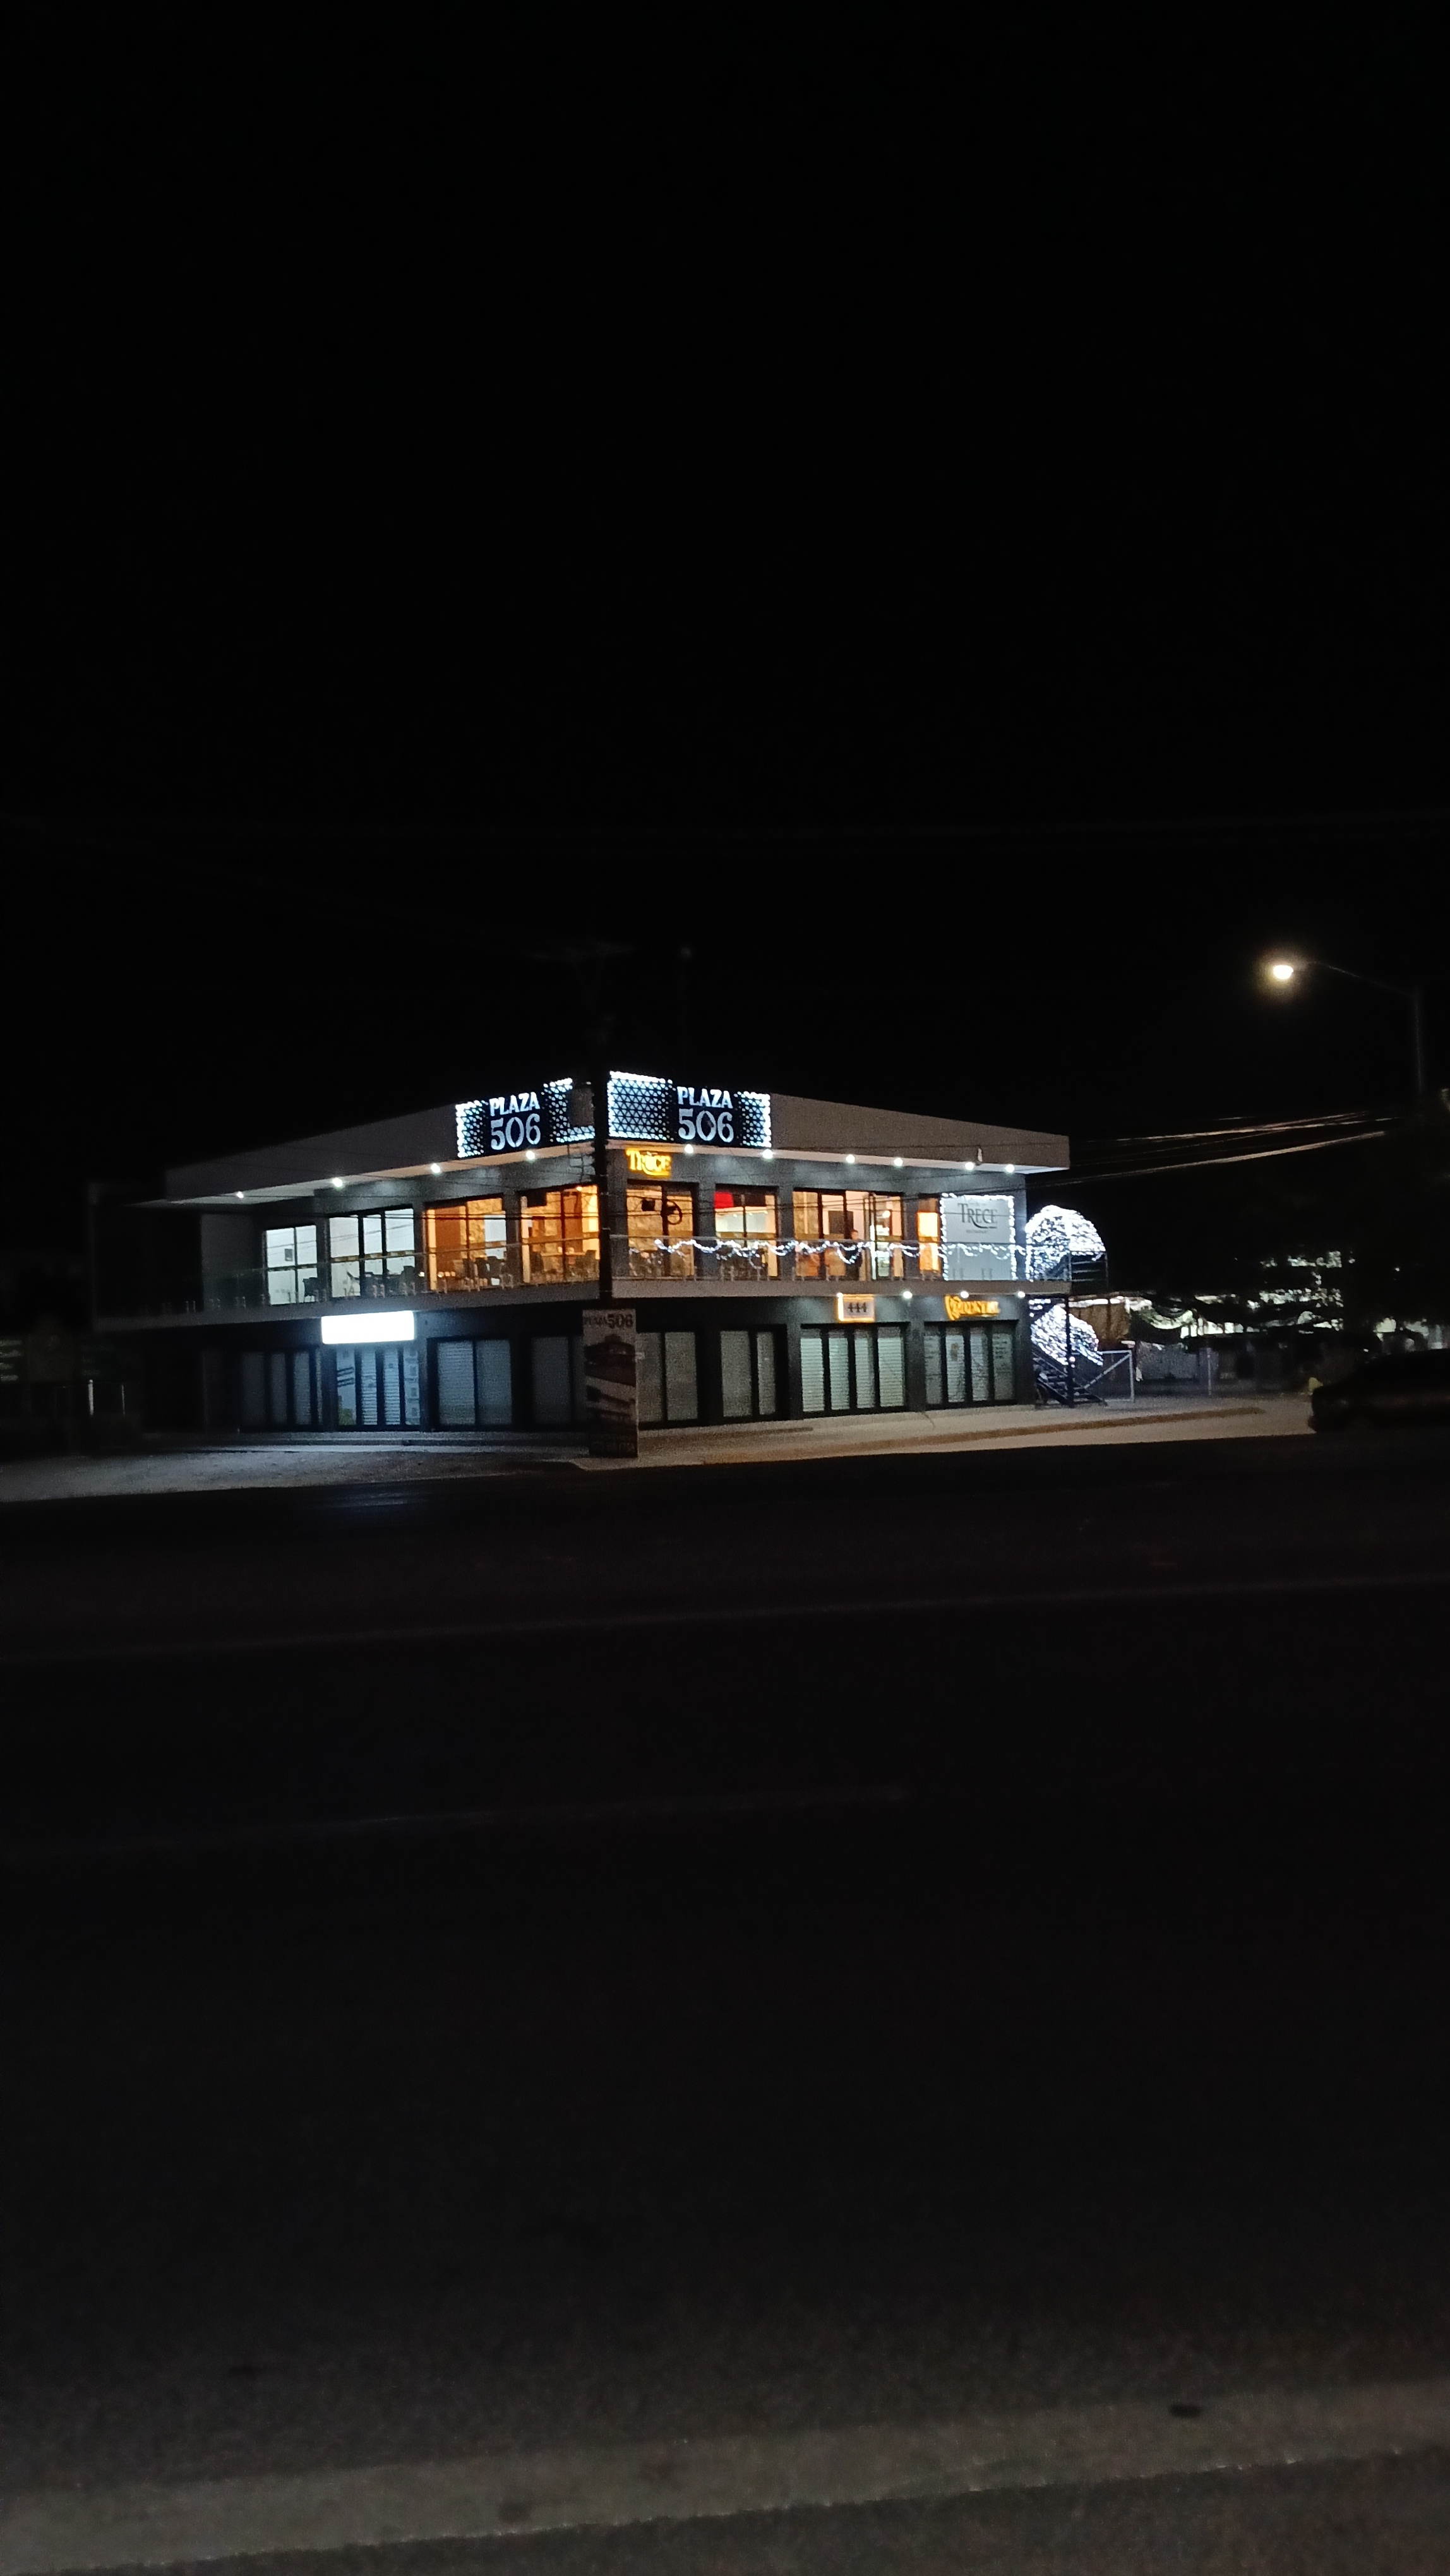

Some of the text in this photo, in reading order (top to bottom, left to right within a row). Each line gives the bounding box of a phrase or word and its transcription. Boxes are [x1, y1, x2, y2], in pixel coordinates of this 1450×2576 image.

[489, 1092, 541, 1116] PLAZA
[677, 1086, 733, 1109] PLAZA
[491, 1113, 541, 1150] 506
[678, 1108, 734, 1143] 506
[957, 1203, 998, 1229] TRECE
